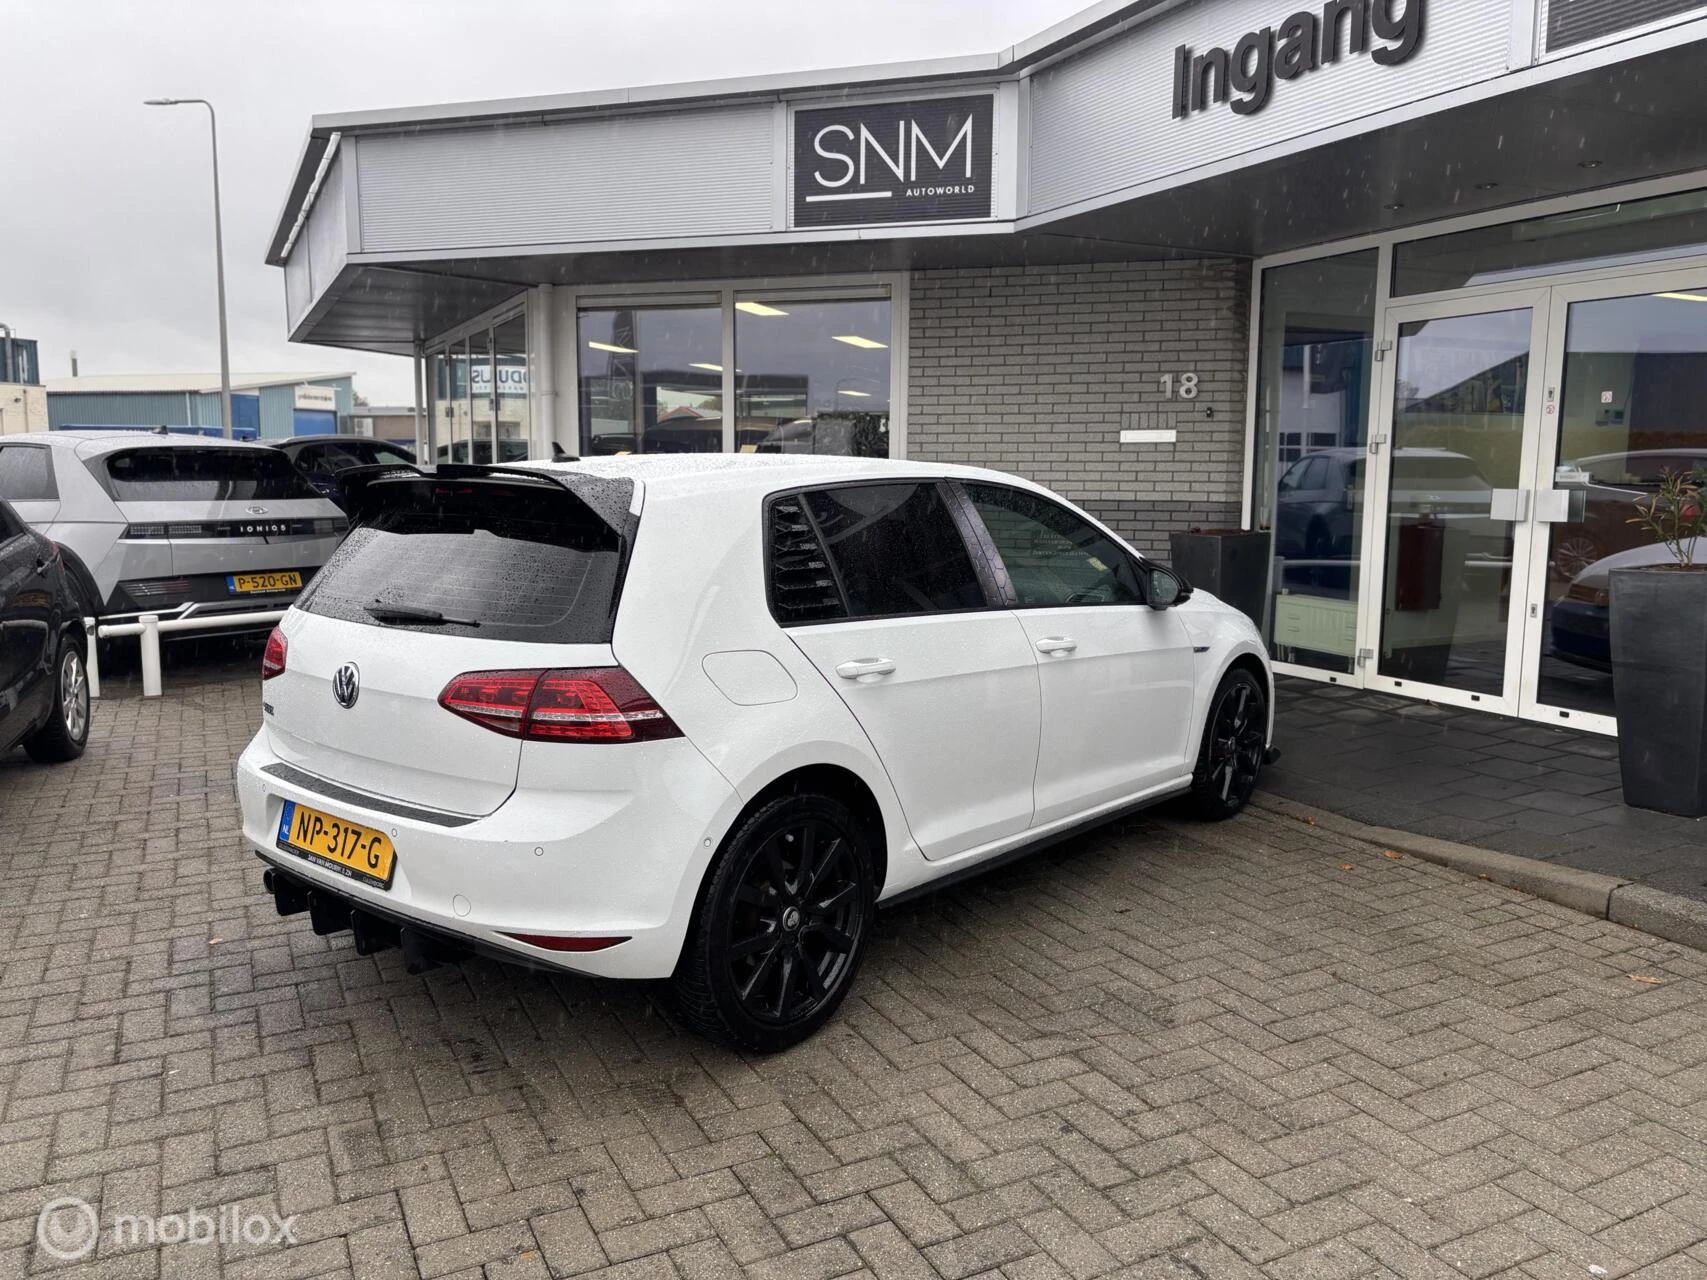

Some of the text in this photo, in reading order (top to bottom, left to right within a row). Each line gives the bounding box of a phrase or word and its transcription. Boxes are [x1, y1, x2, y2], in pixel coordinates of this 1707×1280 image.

[1172, 0, 1422, 119] Ingang
[814, 113, 973, 188] SNM
[905, 185, 975, 197] AUTOWORLD
[1160, 372, 1199, 400] 18
[238, 573, 298, 590] P-520-GN
[296, 811, 382, 869] NP-317-G
